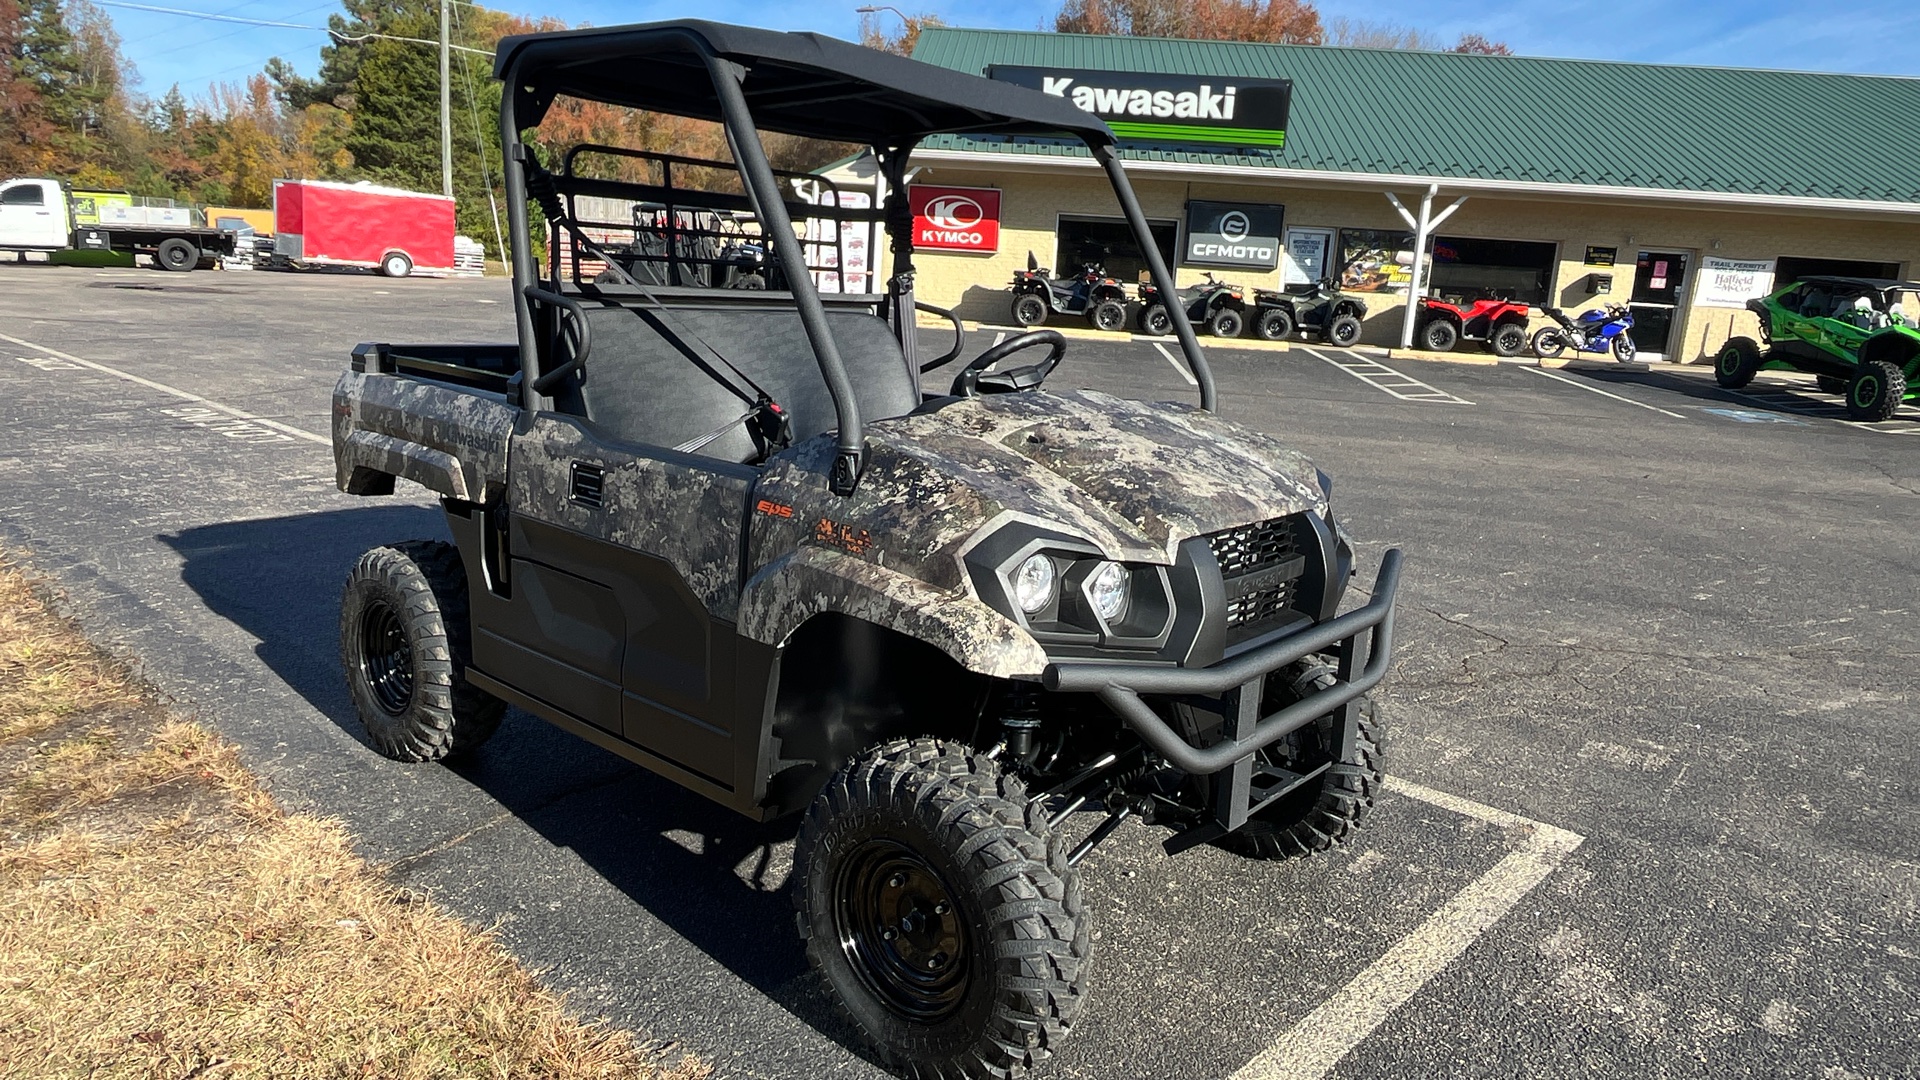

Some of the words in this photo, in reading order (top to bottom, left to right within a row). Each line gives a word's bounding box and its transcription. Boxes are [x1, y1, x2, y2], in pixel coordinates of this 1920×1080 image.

[1043, 77, 1236, 120] Kawasaki
[922, 230, 983, 244] KYMCO
[1192, 243, 1272, 260] CFMOTO
